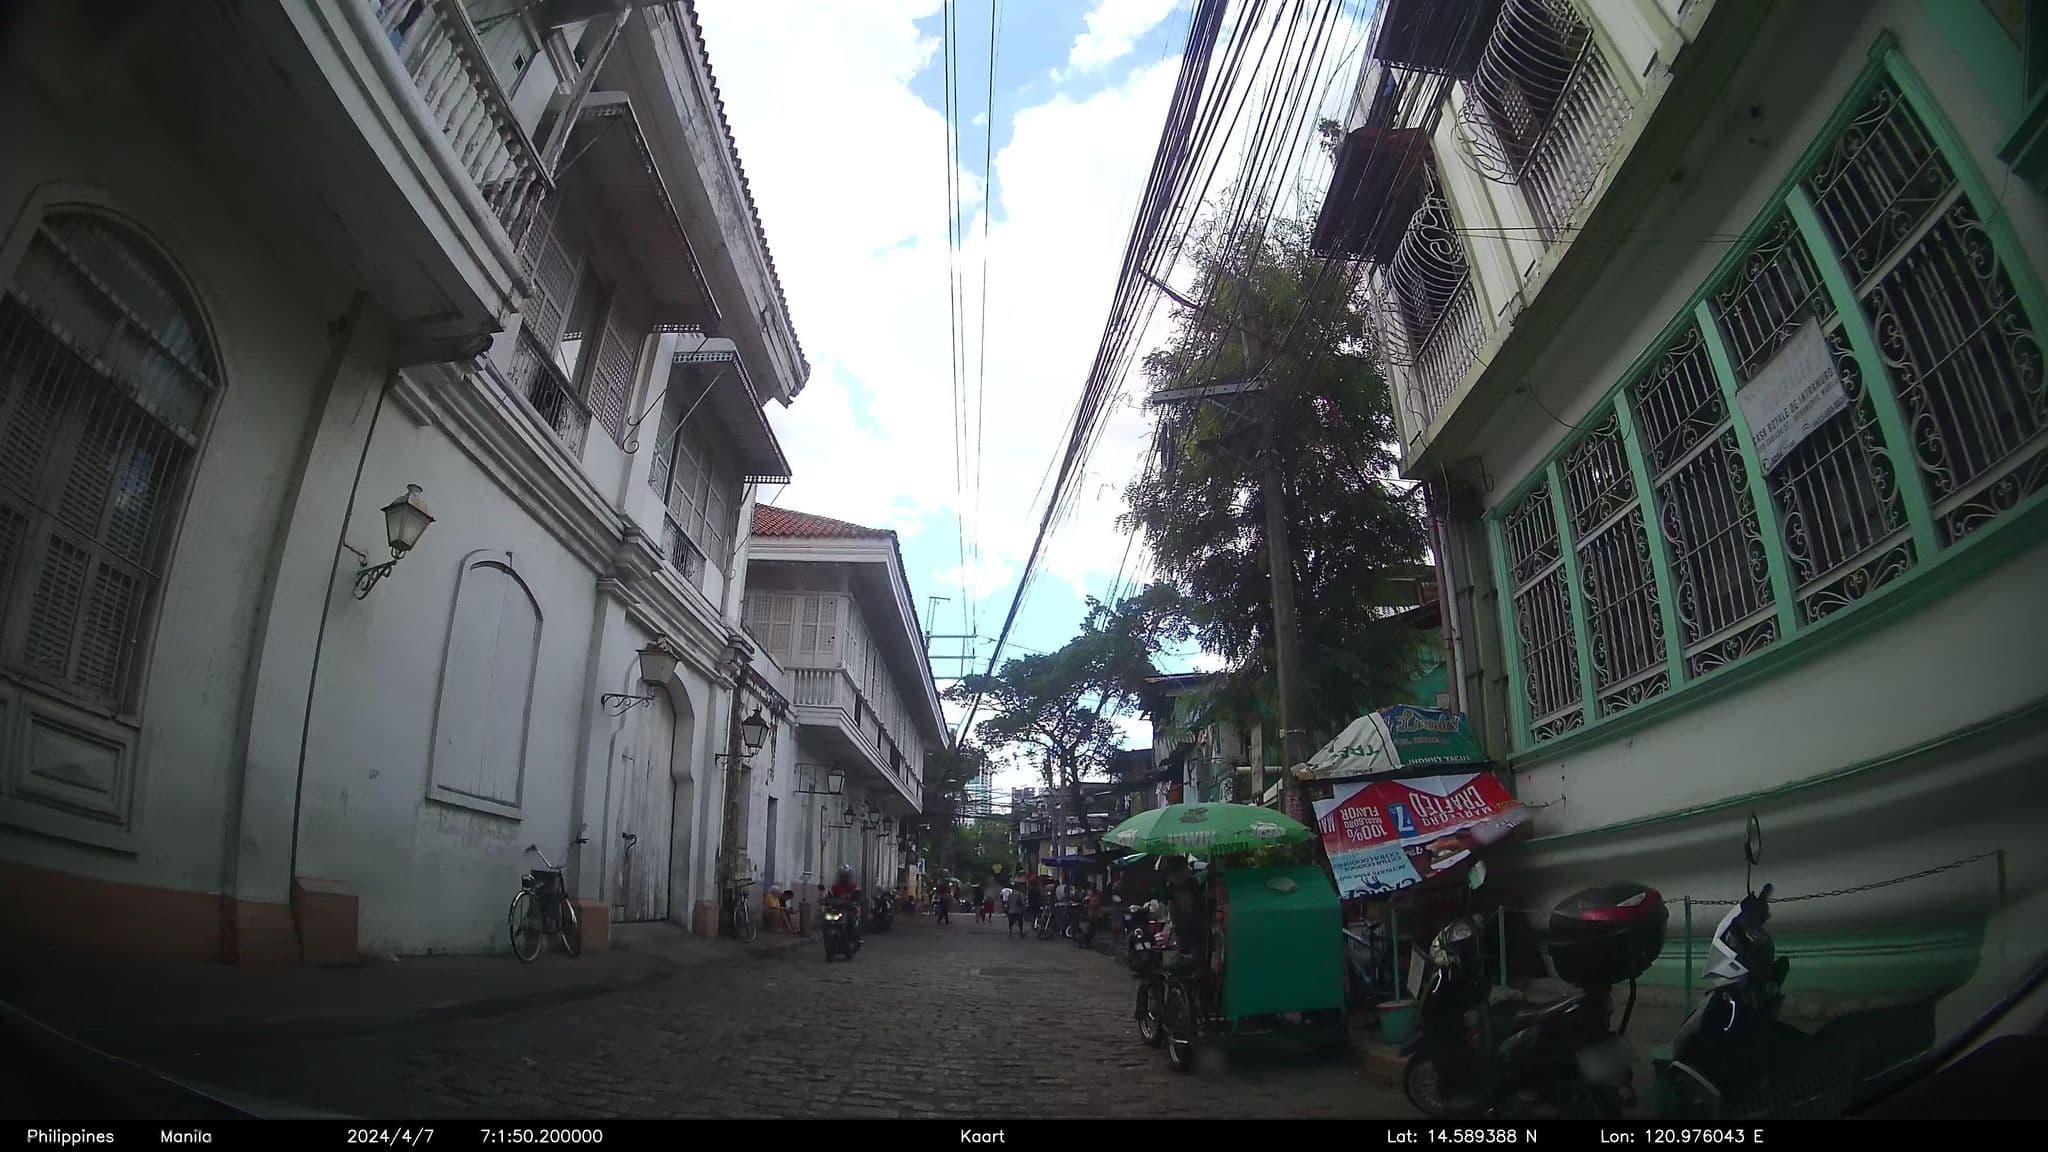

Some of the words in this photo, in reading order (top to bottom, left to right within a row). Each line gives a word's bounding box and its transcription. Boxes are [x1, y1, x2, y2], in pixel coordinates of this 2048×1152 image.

[1408, 785, 1487, 818] CRAFTED
[1341, 805, 1380, 821] FLAVOR
[1396, 806, 1415, 832] 7
[1345, 824, 1388, 842] 100%
